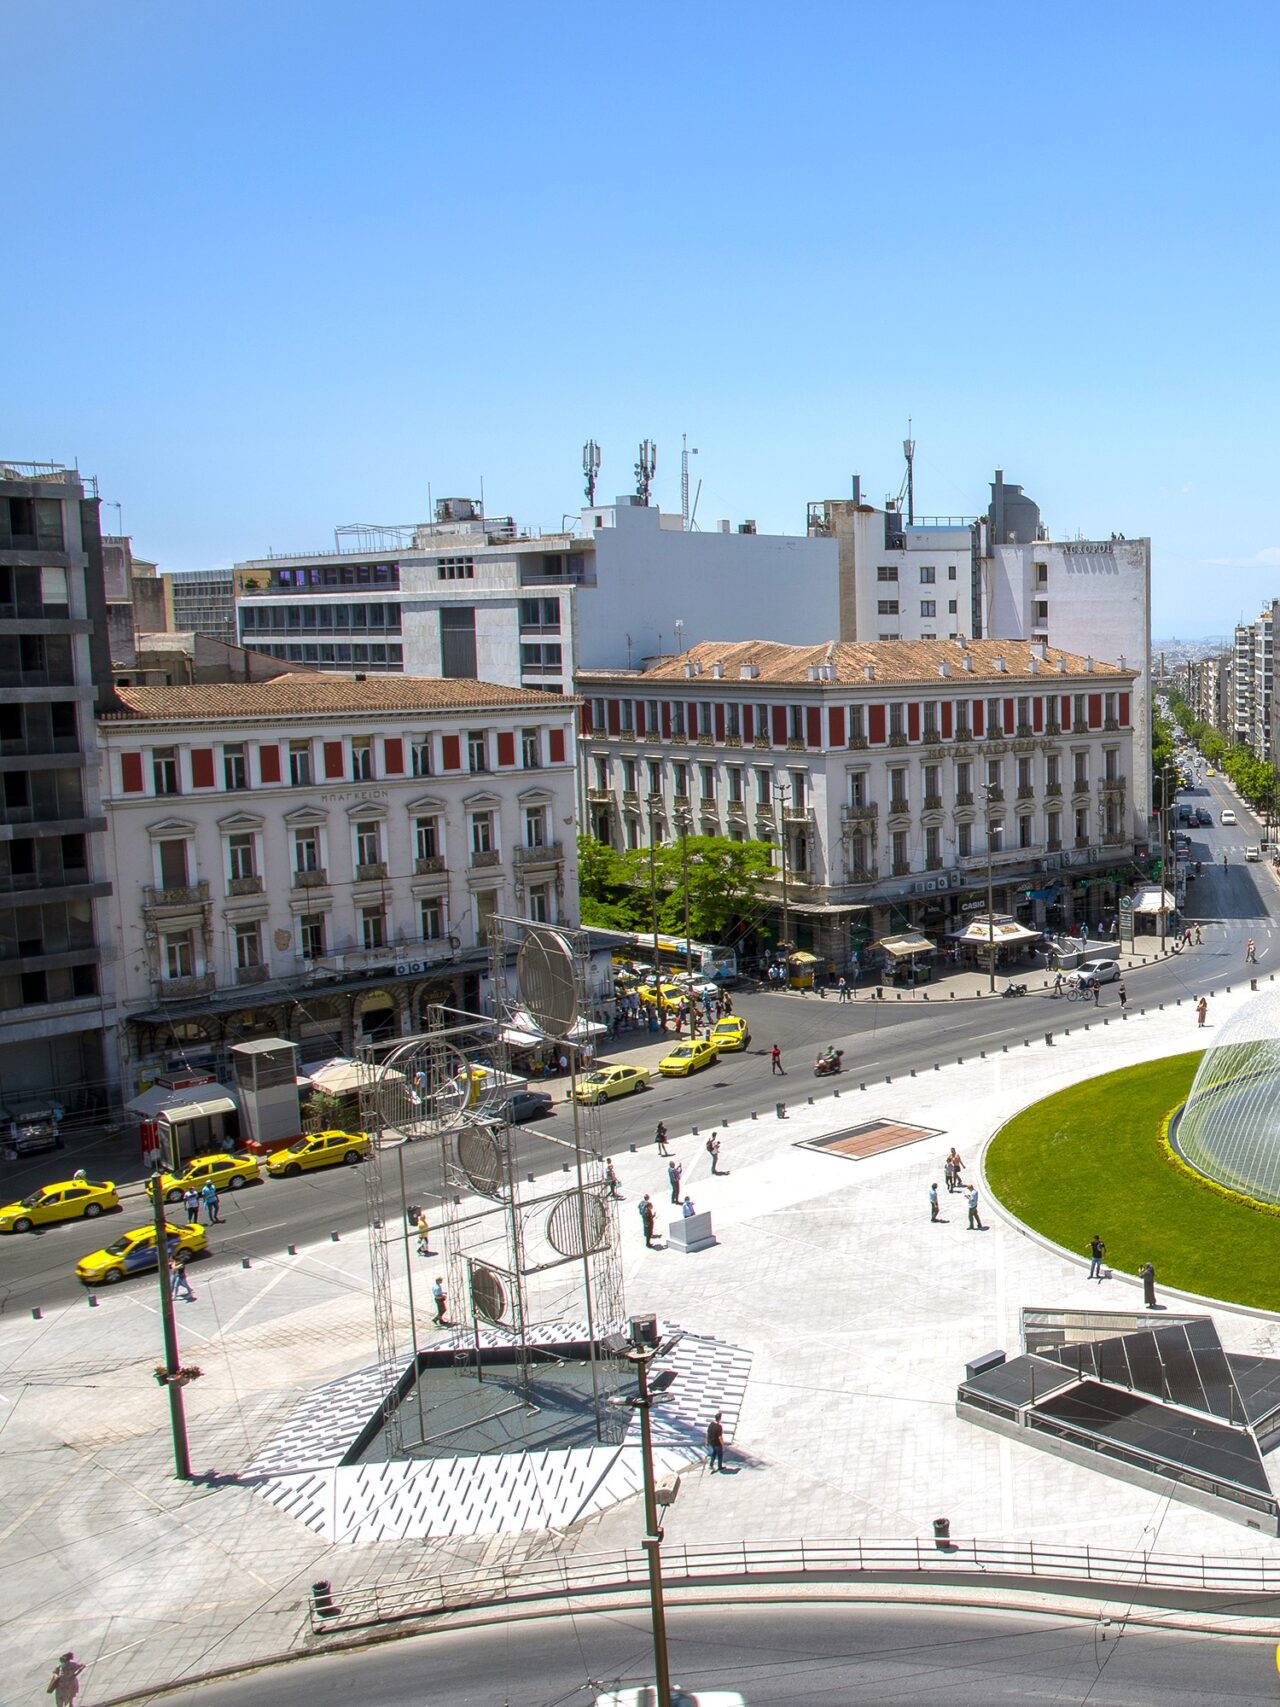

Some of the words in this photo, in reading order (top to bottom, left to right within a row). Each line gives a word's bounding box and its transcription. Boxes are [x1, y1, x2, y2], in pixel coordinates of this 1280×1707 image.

[1063, 543, 1113, 555] ACROPOL
[321, 790, 388, 802] ΜΠΑΓΚΕΙΟΝ
[962, 900, 985, 910] CASIO
